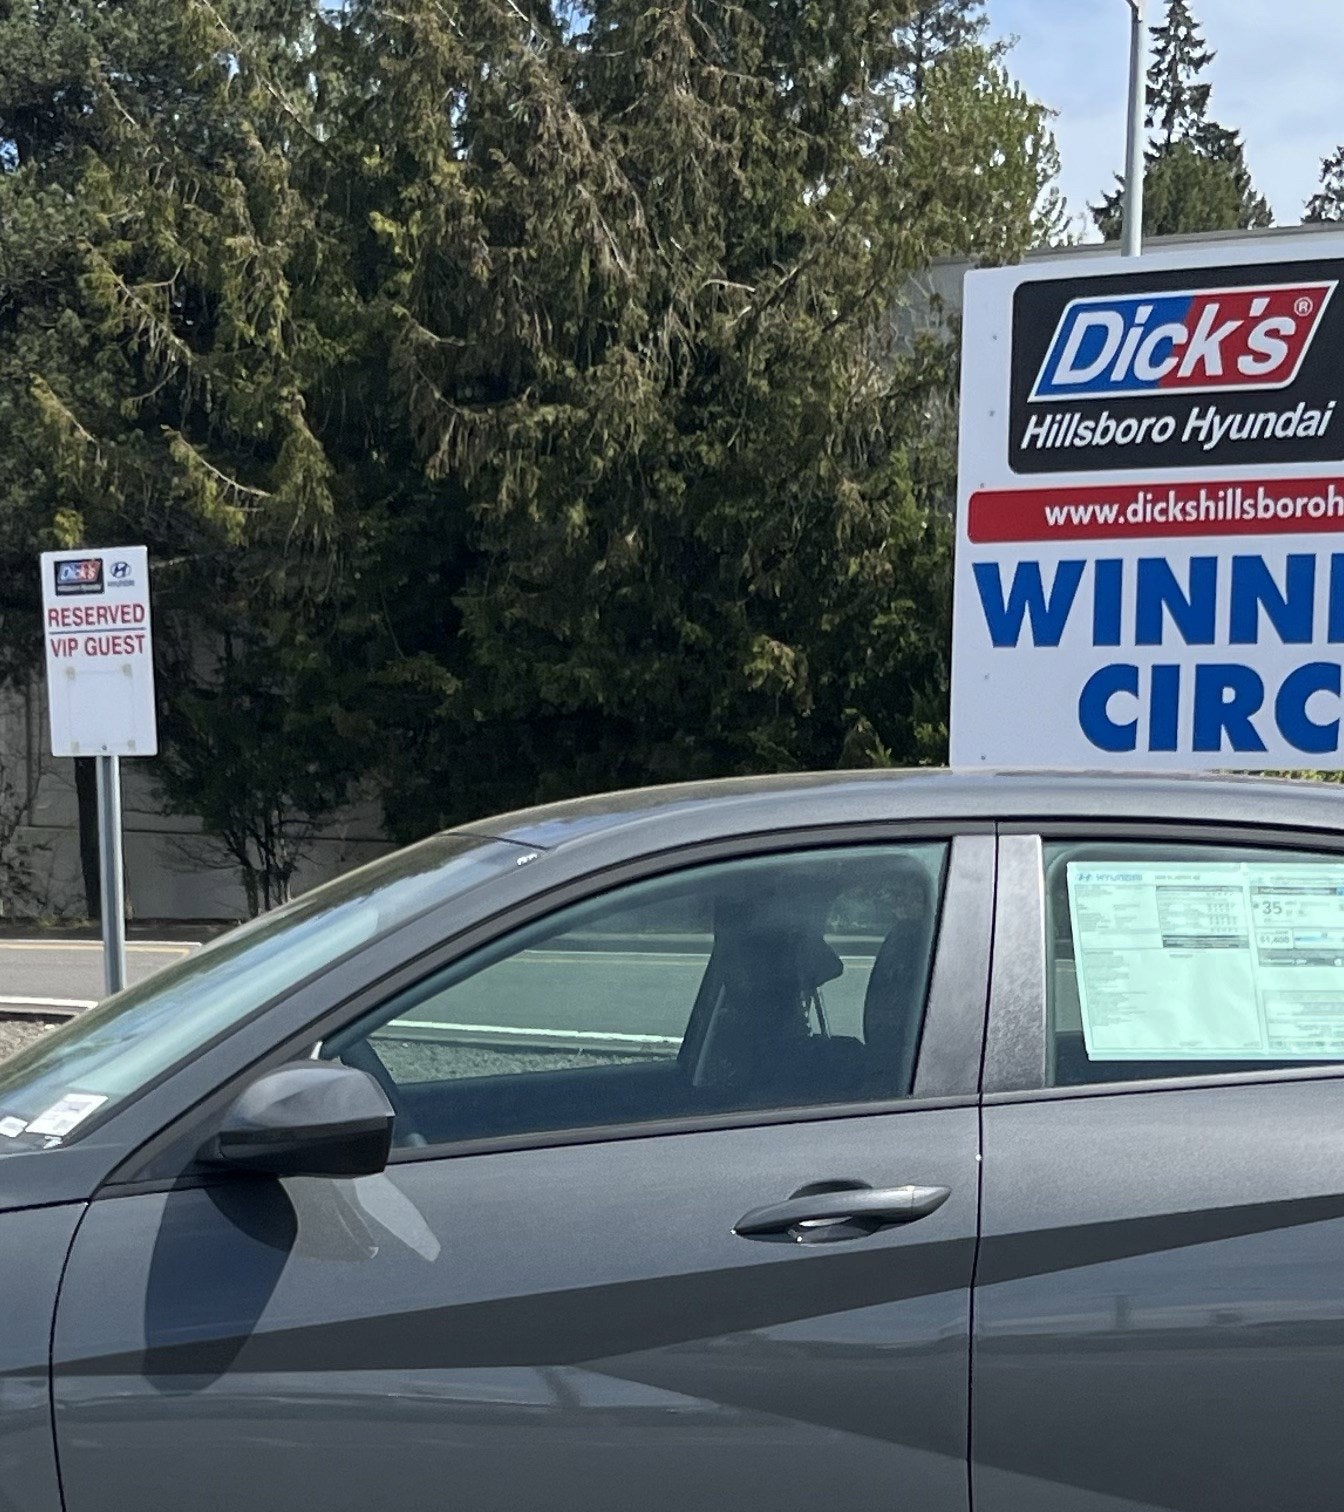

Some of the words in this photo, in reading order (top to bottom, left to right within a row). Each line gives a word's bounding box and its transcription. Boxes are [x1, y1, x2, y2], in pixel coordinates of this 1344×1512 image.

[1020, 411, 1176, 451] Hillsboro
[1181, 400, 1338, 451] Hyundai
[48, 603, 145, 627] RESERVED
[50, 637, 79, 658] VIP
[84, 634, 146, 657] GUEST
